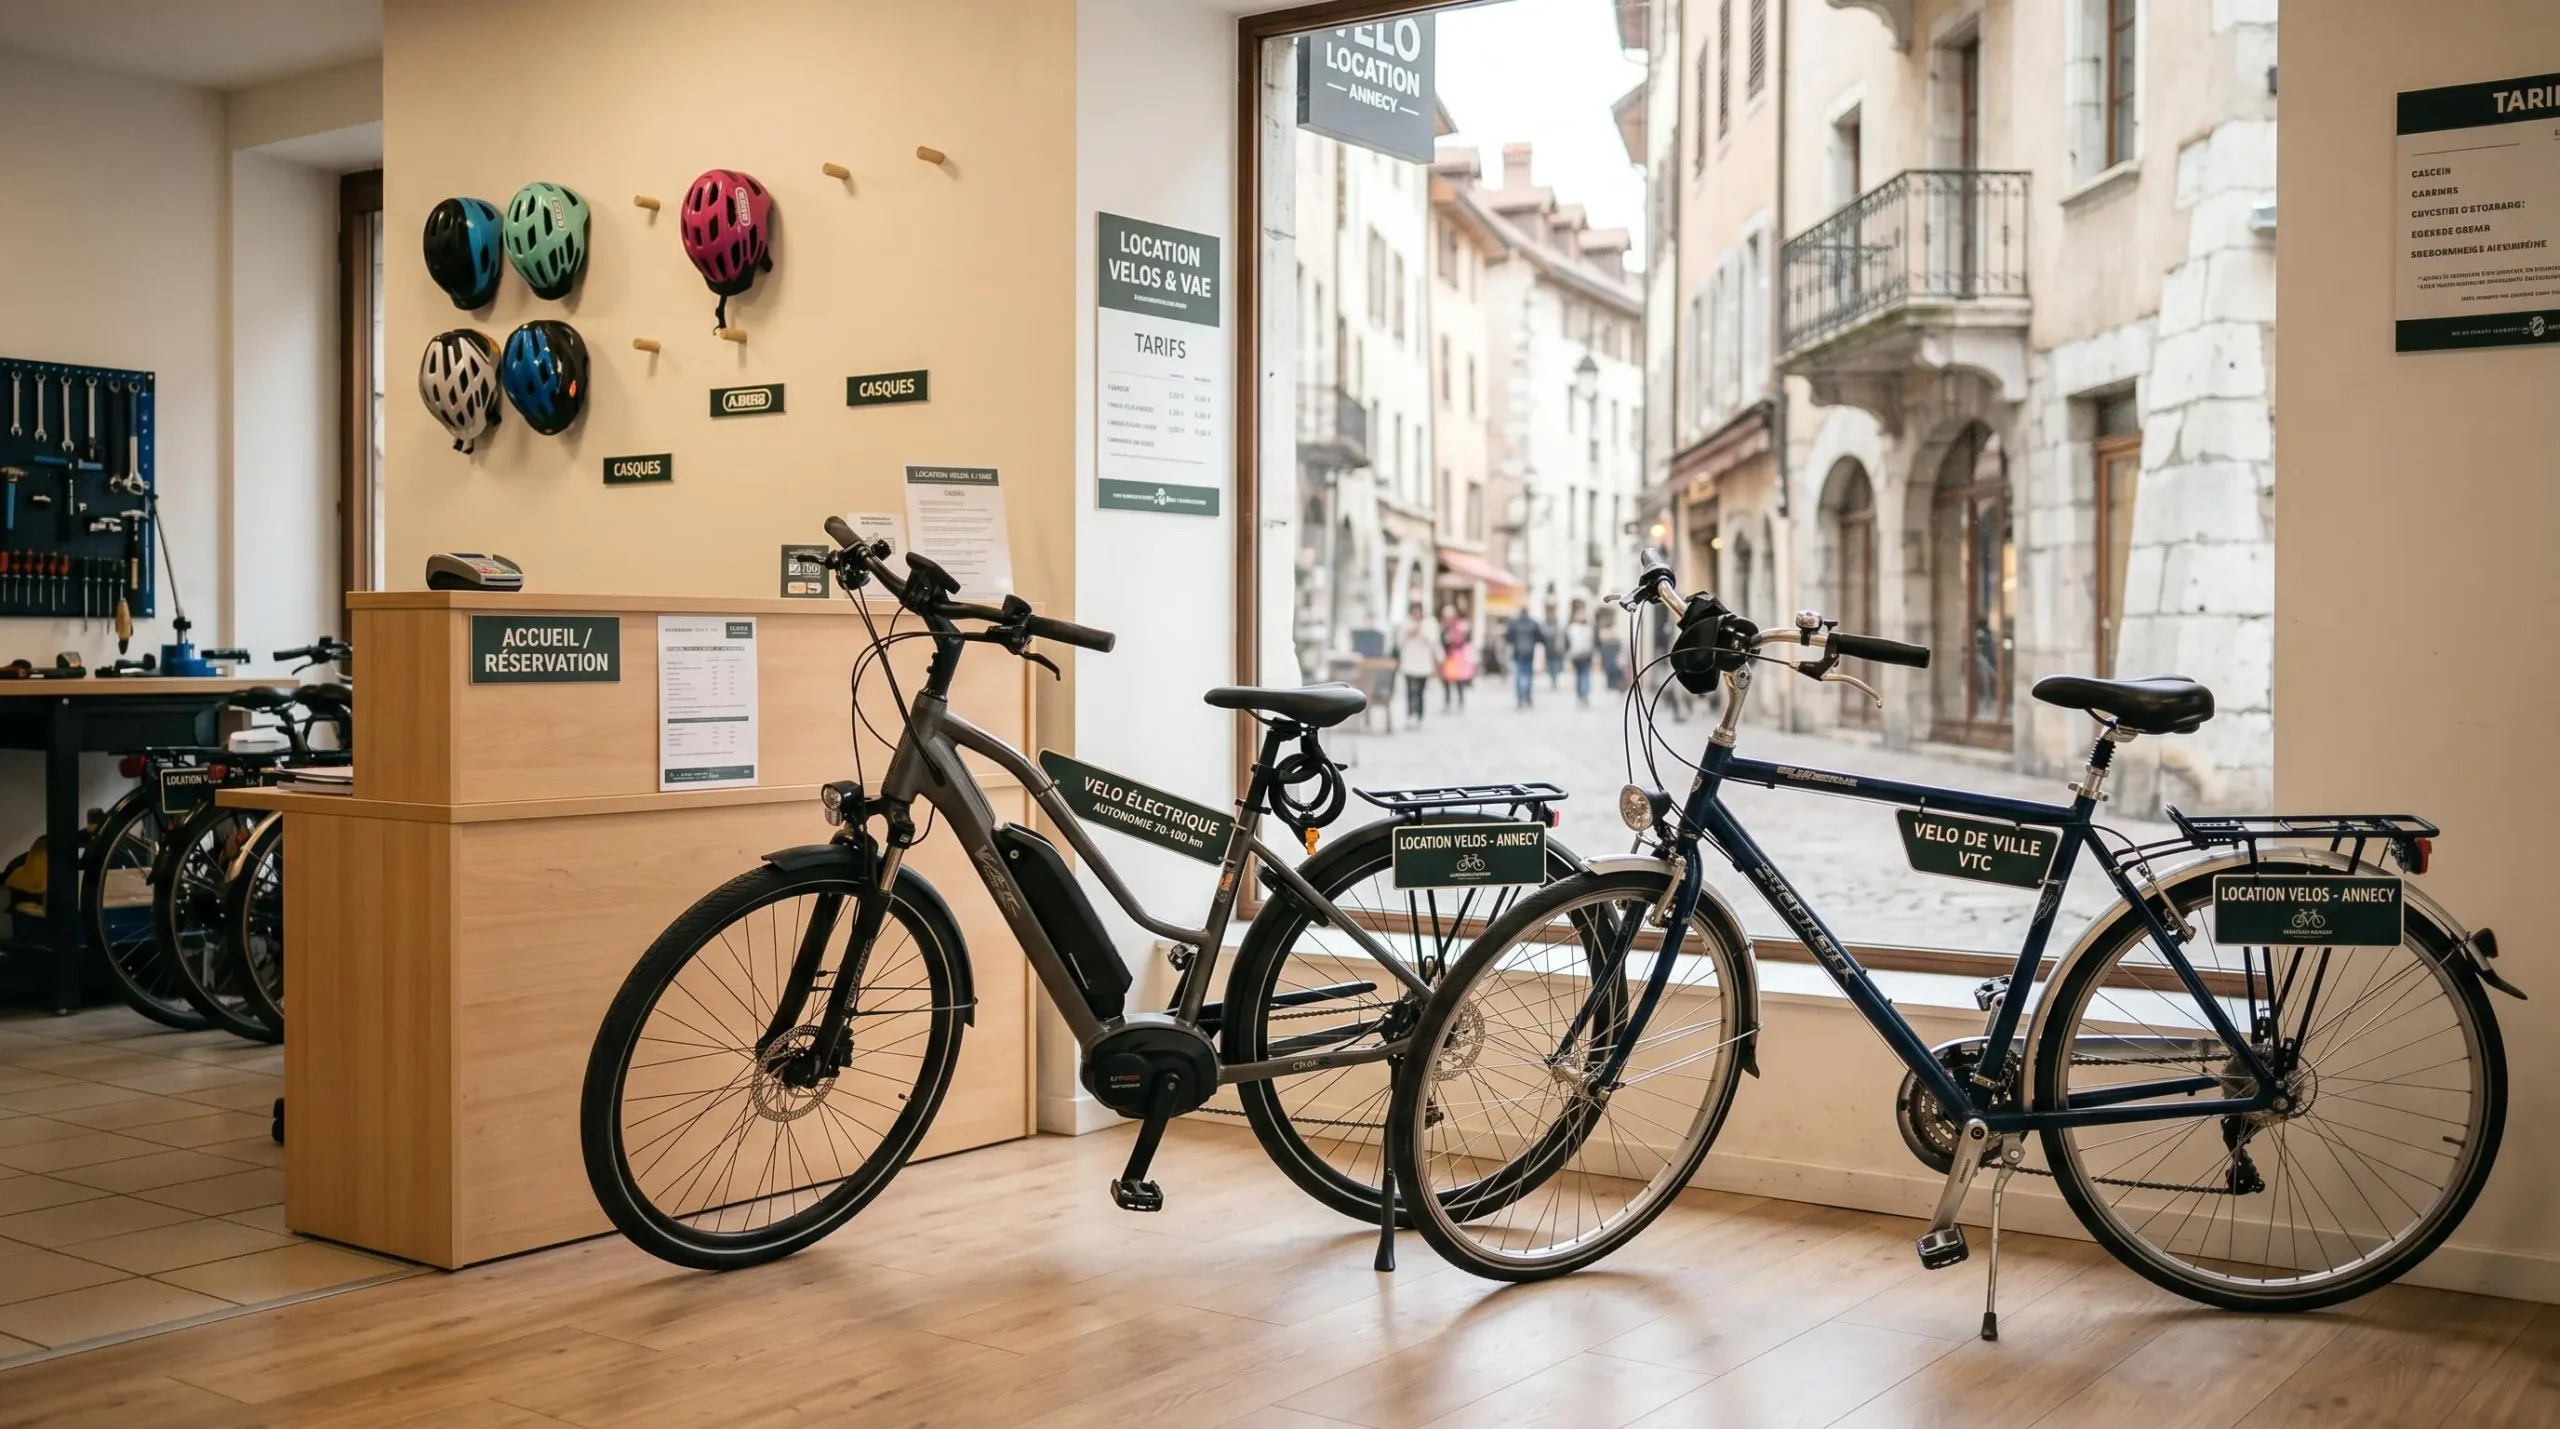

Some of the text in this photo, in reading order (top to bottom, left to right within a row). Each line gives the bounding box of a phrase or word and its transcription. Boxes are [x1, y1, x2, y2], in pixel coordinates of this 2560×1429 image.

[1326, 41, 1420, 98] LOCATION
[1349, 83, 1398, 113] ANNECY
[1120, 231, 1200, 267] LOCATION
[1108, 258, 1211, 298] VELOS & VAE
[1134, 332, 1186, 359] TARIFS
[859, 378, 915, 398] CASQUES
[614, 460, 661, 478] CASQUES
[502, 628, 593, 649] ACCUEIL /
[485, 649, 609, 673] RÉSERVATION
[1084, 776, 1220, 836] VELO ÉLECTRIQUE
[1093, 802, 1203, 848] AUTONOMIE 70-100 km
[1400, 835, 1451, 850] LOCATION
[1454, 834, 1487, 848] VELOS
[1496, 832, 1539, 847] ANNECY
[1914, 822, 2042, 857] VELO DE VILLE
[1959, 851, 1993, 871] VTC
[2221, 886, 2285, 901] LOCATION
[2288, 887, 2329, 902] VELOS
[2341, 888, 2395, 903] ANNECY
